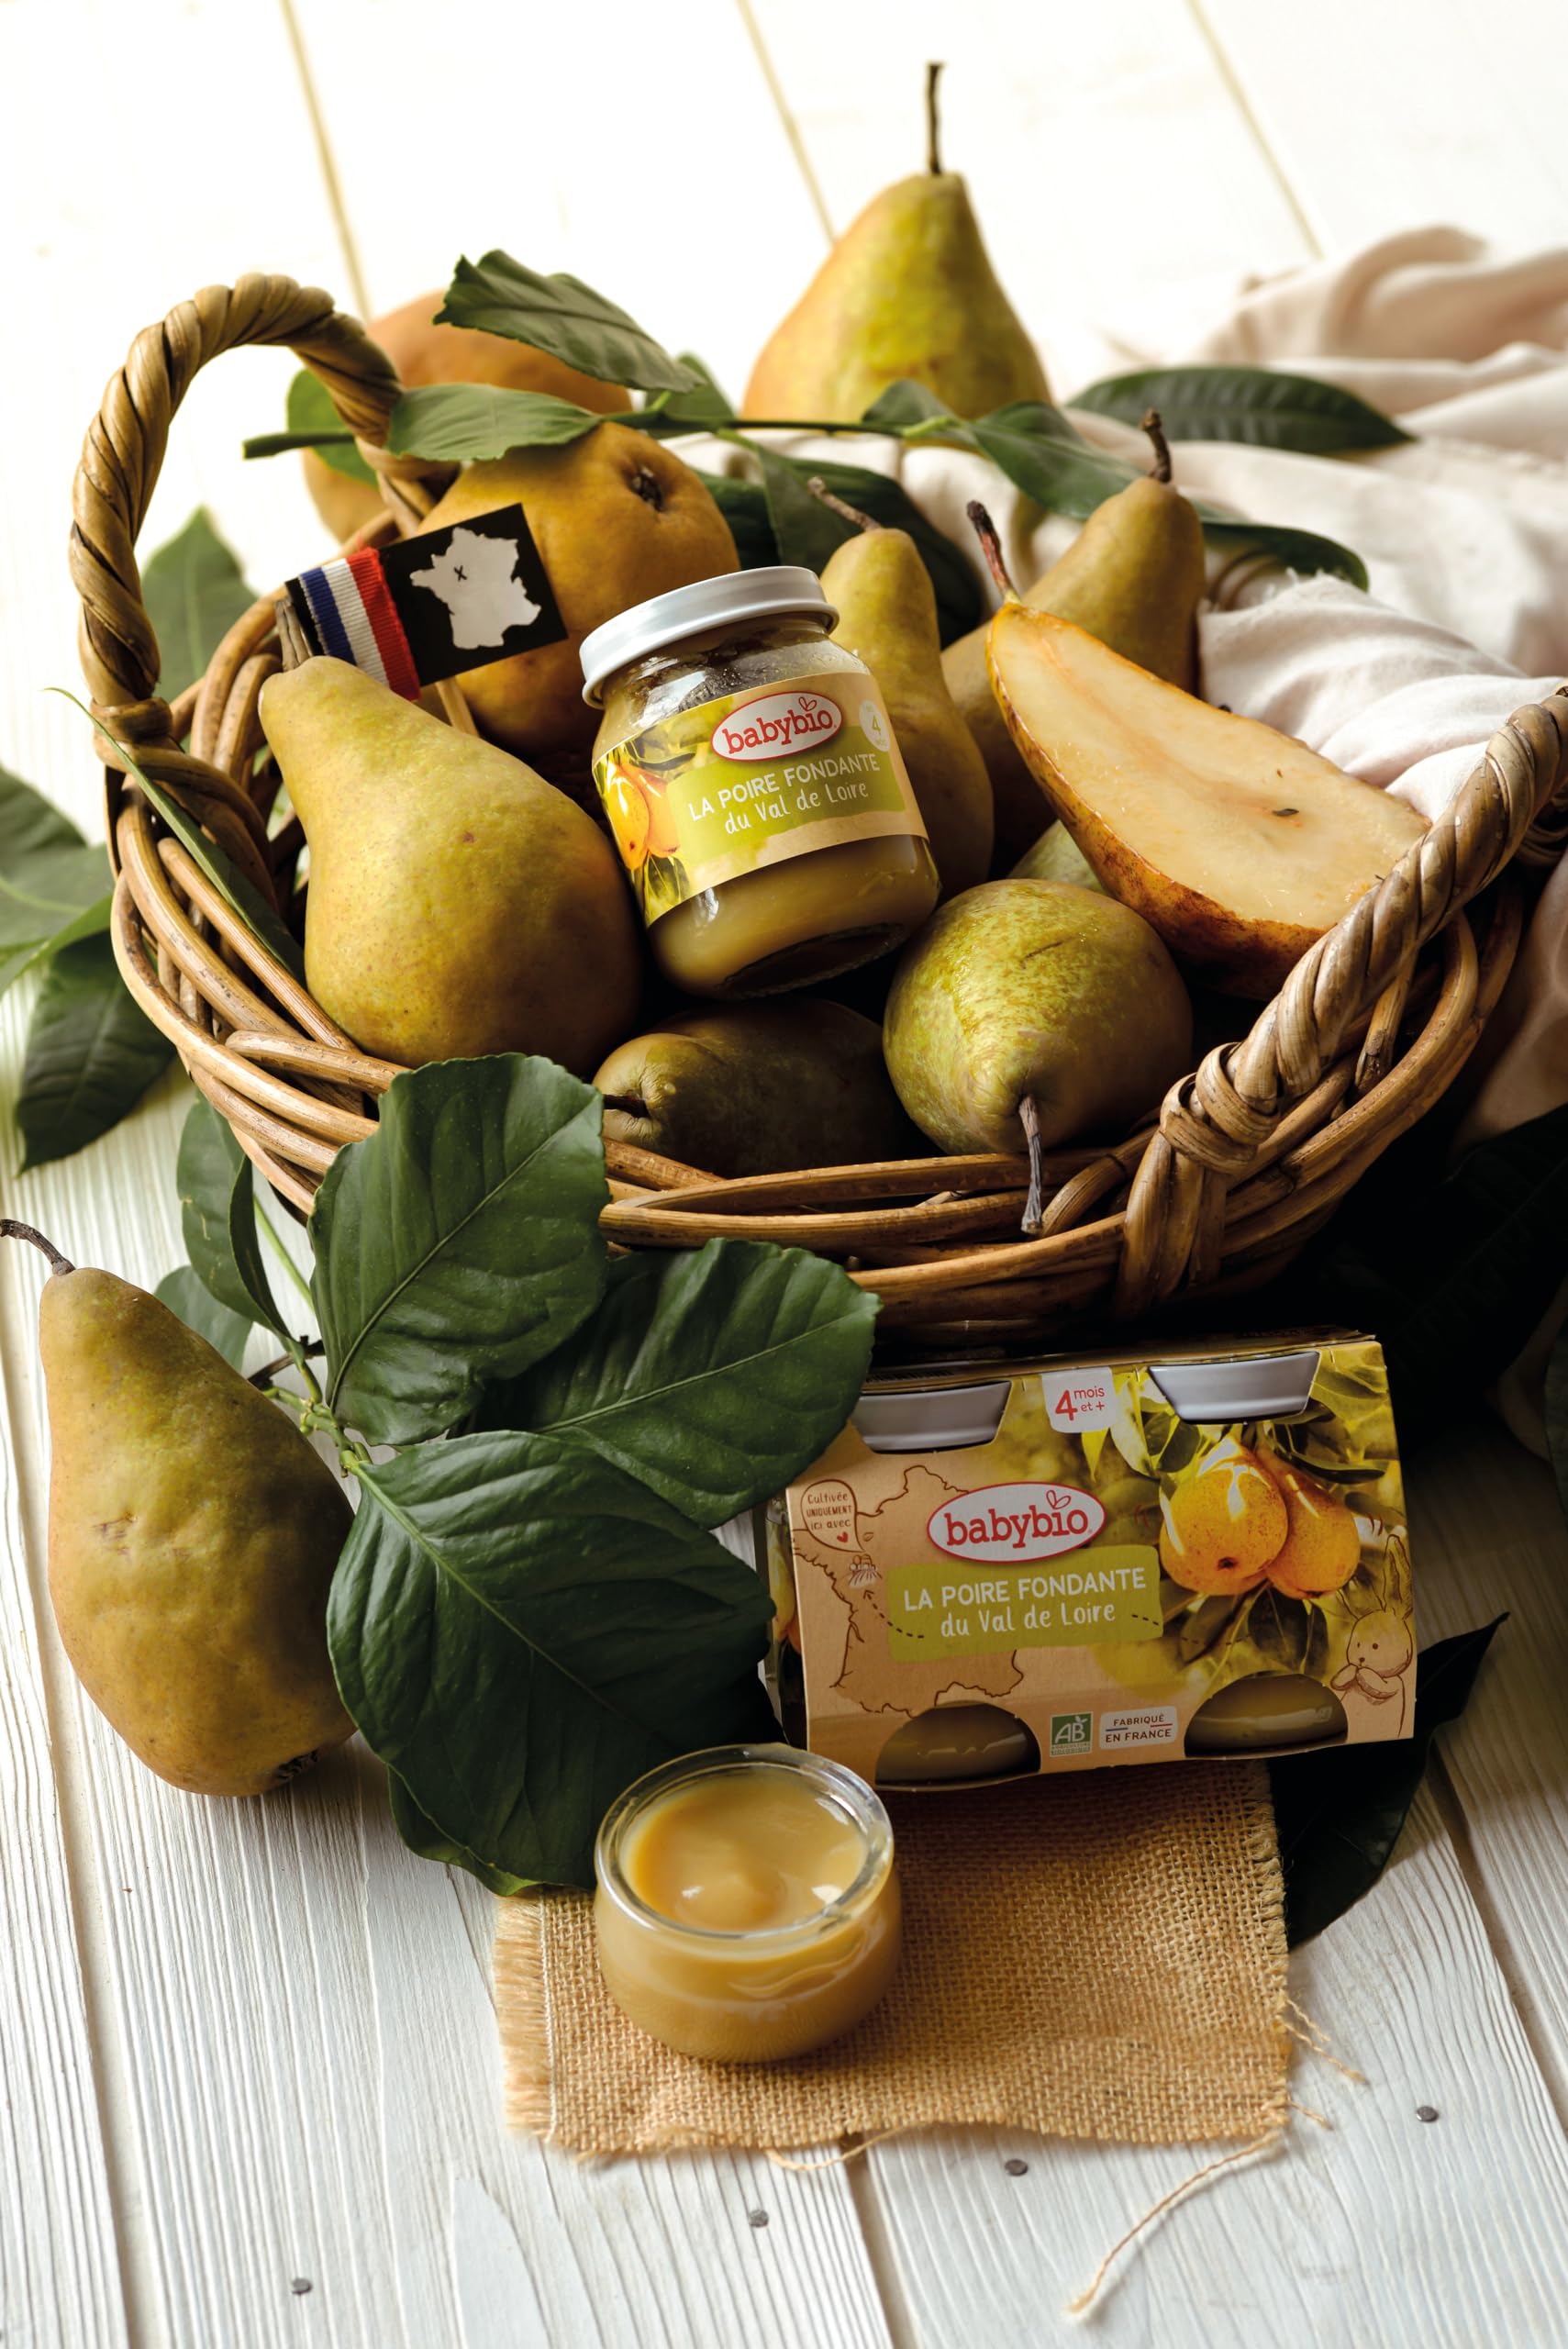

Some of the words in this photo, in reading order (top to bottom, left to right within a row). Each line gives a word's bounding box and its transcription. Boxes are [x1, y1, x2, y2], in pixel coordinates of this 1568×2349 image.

[722, 709, 833, 754] babybio
[689, 796, 715, 821] LA
[717, 773, 780, 808] POIRE
[784, 753, 881, 786] FONDANTE
[725, 810, 752, 834] du
[754, 795, 791, 821] Val
[796, 788, 821, 811] de
[826, 782, 869, 804] Loire
[1055, 1389, 1078, 1421] 4
[1073, 1386, 1106, 1400] mois
[1081, 1401, 1094, 1412] et
[806, 1505, 851, 1518] UNIQUEMENT
[807, 1491, 849, 1505] Cultivée
[826, 1519, 851, 1530] avec
[943, 1504, 1089, 1549] babybio
[904, 1589, 933, 1611] LA
[941, 1580, 1009, 1607] POIRE
[1018, 1567, 1147, 1600] FONDANTE
[940, 1613, 970, 1638] du
[978, 1607, 1015, 1632] Val
[1023, 1606, 1052, 1630] de
[1060, 1602, 1117, 1626] Loire
[1055, 1722, 1086, 1744] AB
[1113, 1712, 1165, 1727] FABRIQUÉ
[1105, 1733, 1121, 1743] EN
[1125, 1728, 1172, 1741] FRANCE
